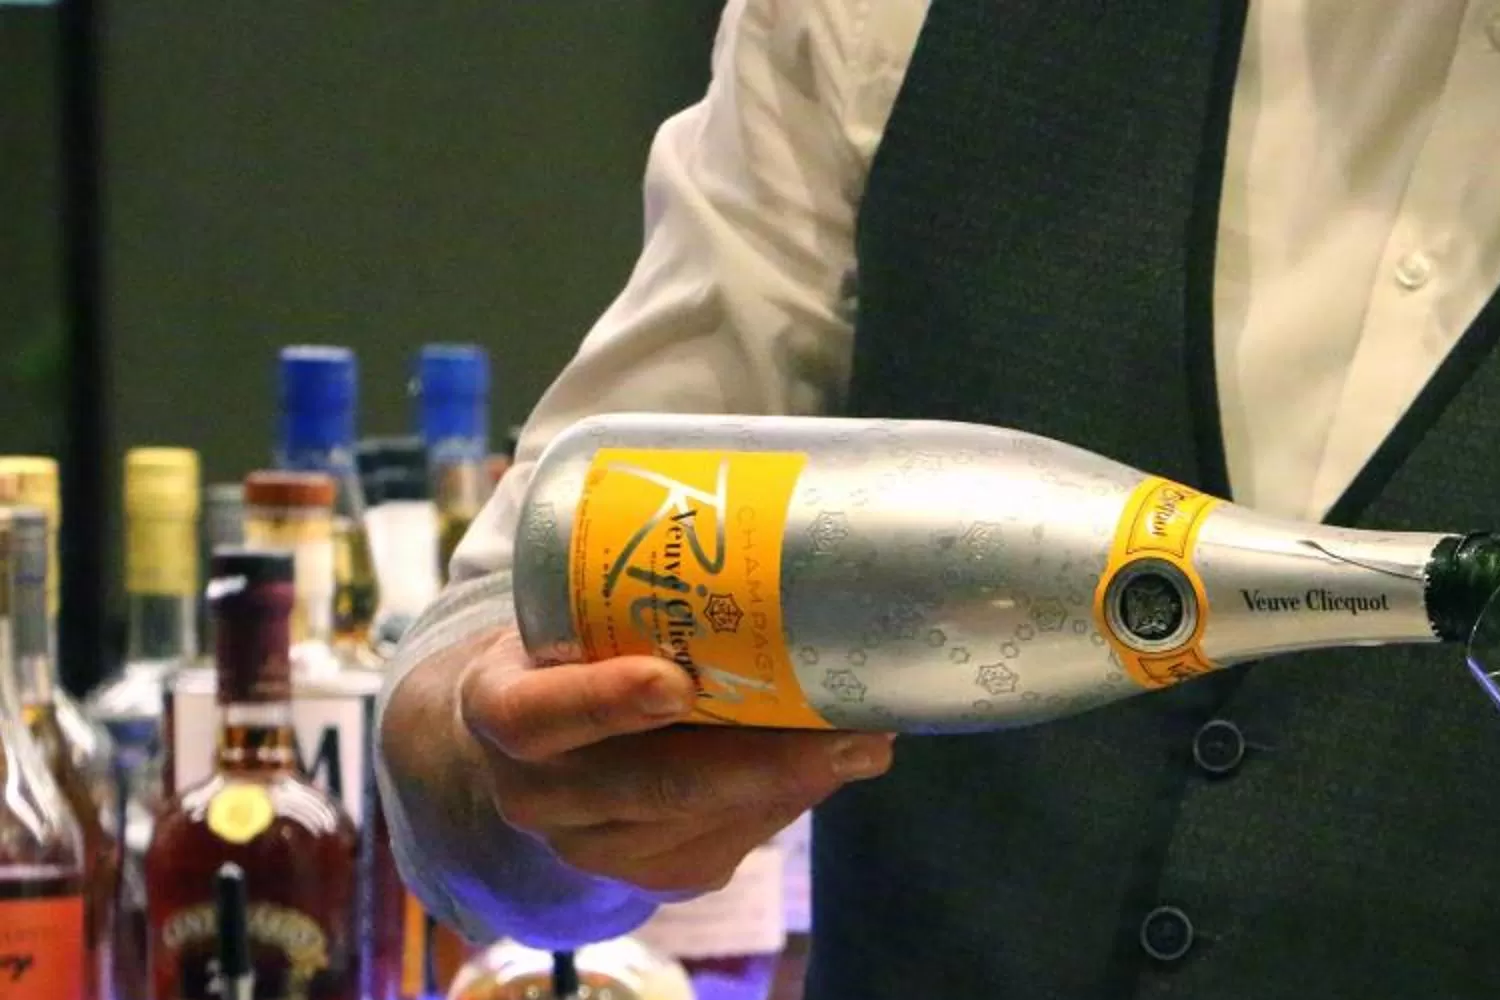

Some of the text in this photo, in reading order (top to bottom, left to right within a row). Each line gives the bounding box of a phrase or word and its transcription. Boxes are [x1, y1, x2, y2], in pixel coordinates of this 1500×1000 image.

[664, 509, 698, 593] Veuve
[1239, 588, 1391, 616] Veuve Clicquot
